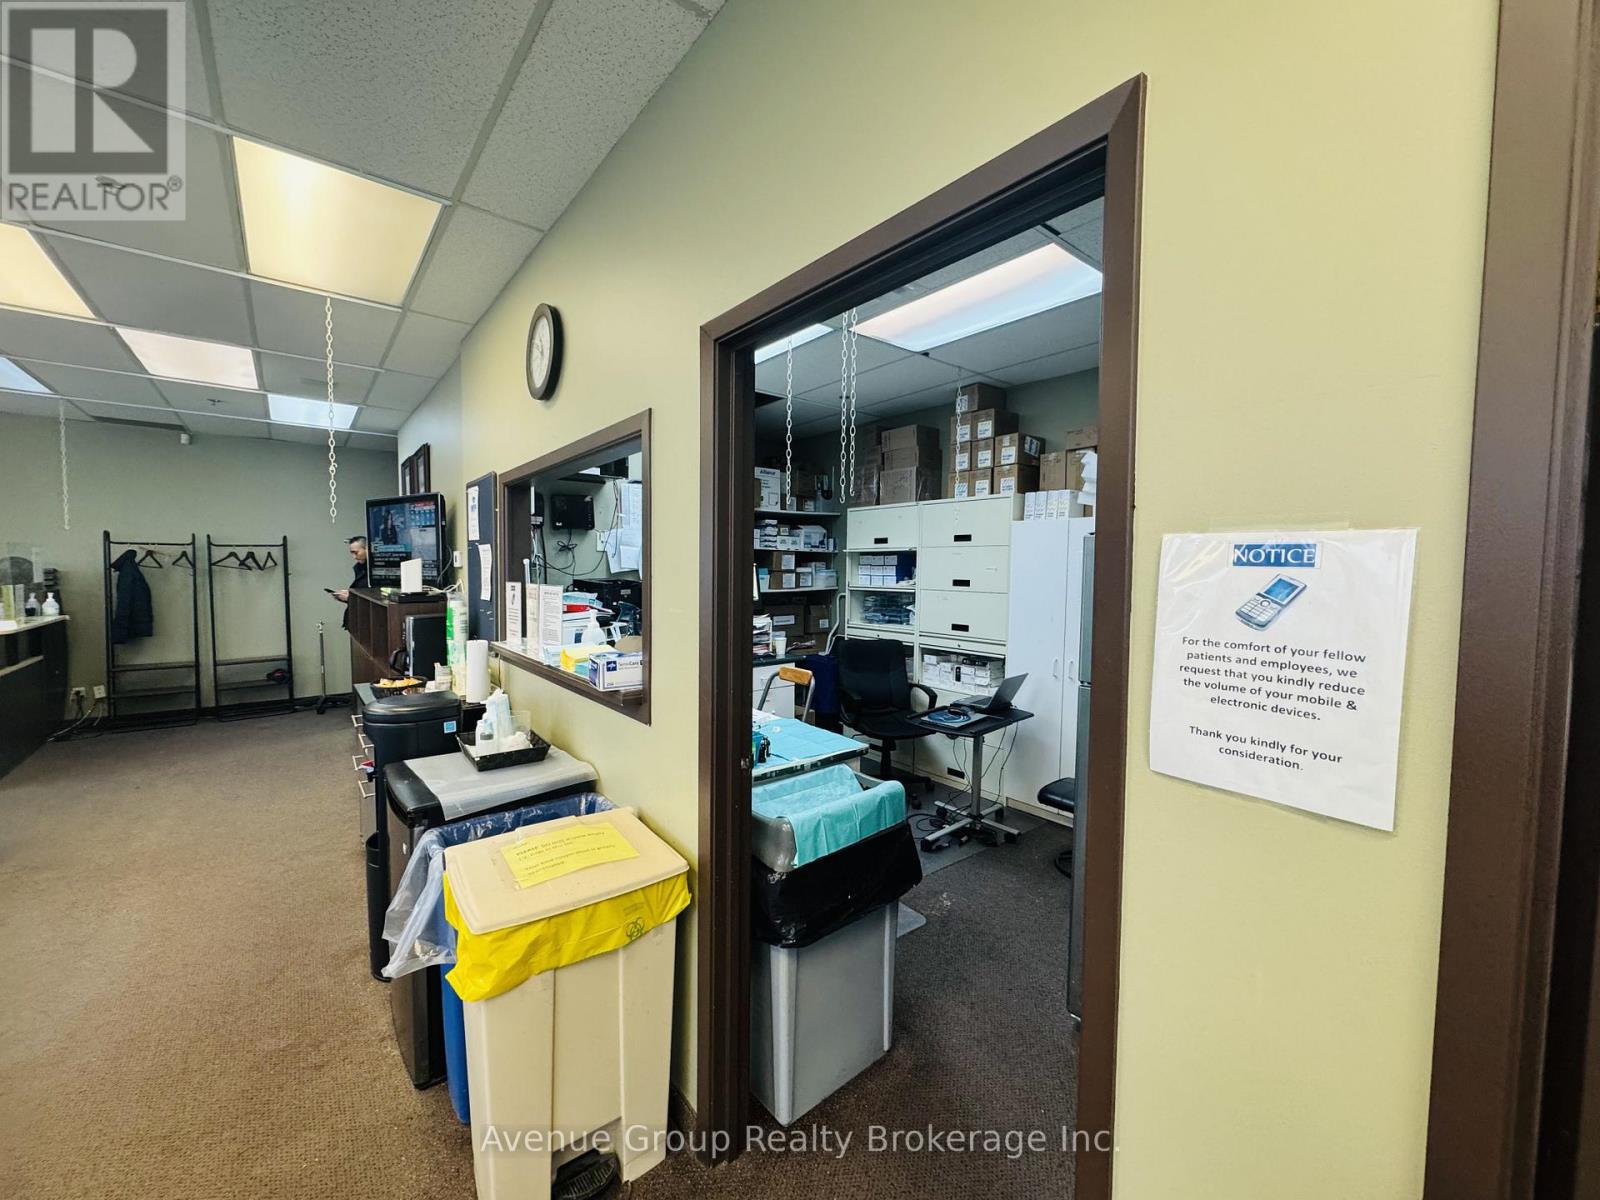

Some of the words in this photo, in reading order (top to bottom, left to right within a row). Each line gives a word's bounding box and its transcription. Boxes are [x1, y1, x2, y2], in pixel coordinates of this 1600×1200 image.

[1233, 548, 1316, 564] NOTICE
[1182, 636, 1200, 646] For
[1202, 638, 1221, 648] the
[1223, 641, 1271, 653] comfort
[1274, 645, 1288, 654] of
[1290, 647, 1319, 657] your
[1323, 649, 1367, 663] fellow
[1186, 652, 1232, 663] patients
[1235, 656, 1257, 666] and
[1260, 659, 1333, 676] employees,
[1336, 668, 1358, 678] we
[1179, 665, 1221, 676] request
[1224, 668, 1247, 680] that
[1250, 672, 1273, 683] you
[1276, 674, 1315, 690] kindly
[1318, 682, 1366, 696] reduce
[1183, 677, 1201, 688] the
[1203, 681, 1247, 694] volume
[1249, 686, 1263, 696] of
[1265, 690, 1294, 700] your
[1296, 694, 1342, 708] mobile
[1345, 700, 1358, 711] &
[1210, 695, 1268, 712] electronic
[1270, 704, 1321, 721] devices.
[1189, 725, 1223, 740] Thank
[1225, 733, 1247, 744] you
[1250, 736, 1287, 753] kindly
[1289, 743, 1309, 756] for
[1311, 750, 1343, 763] your
[1218, 745, 1304, 771] consideration.
